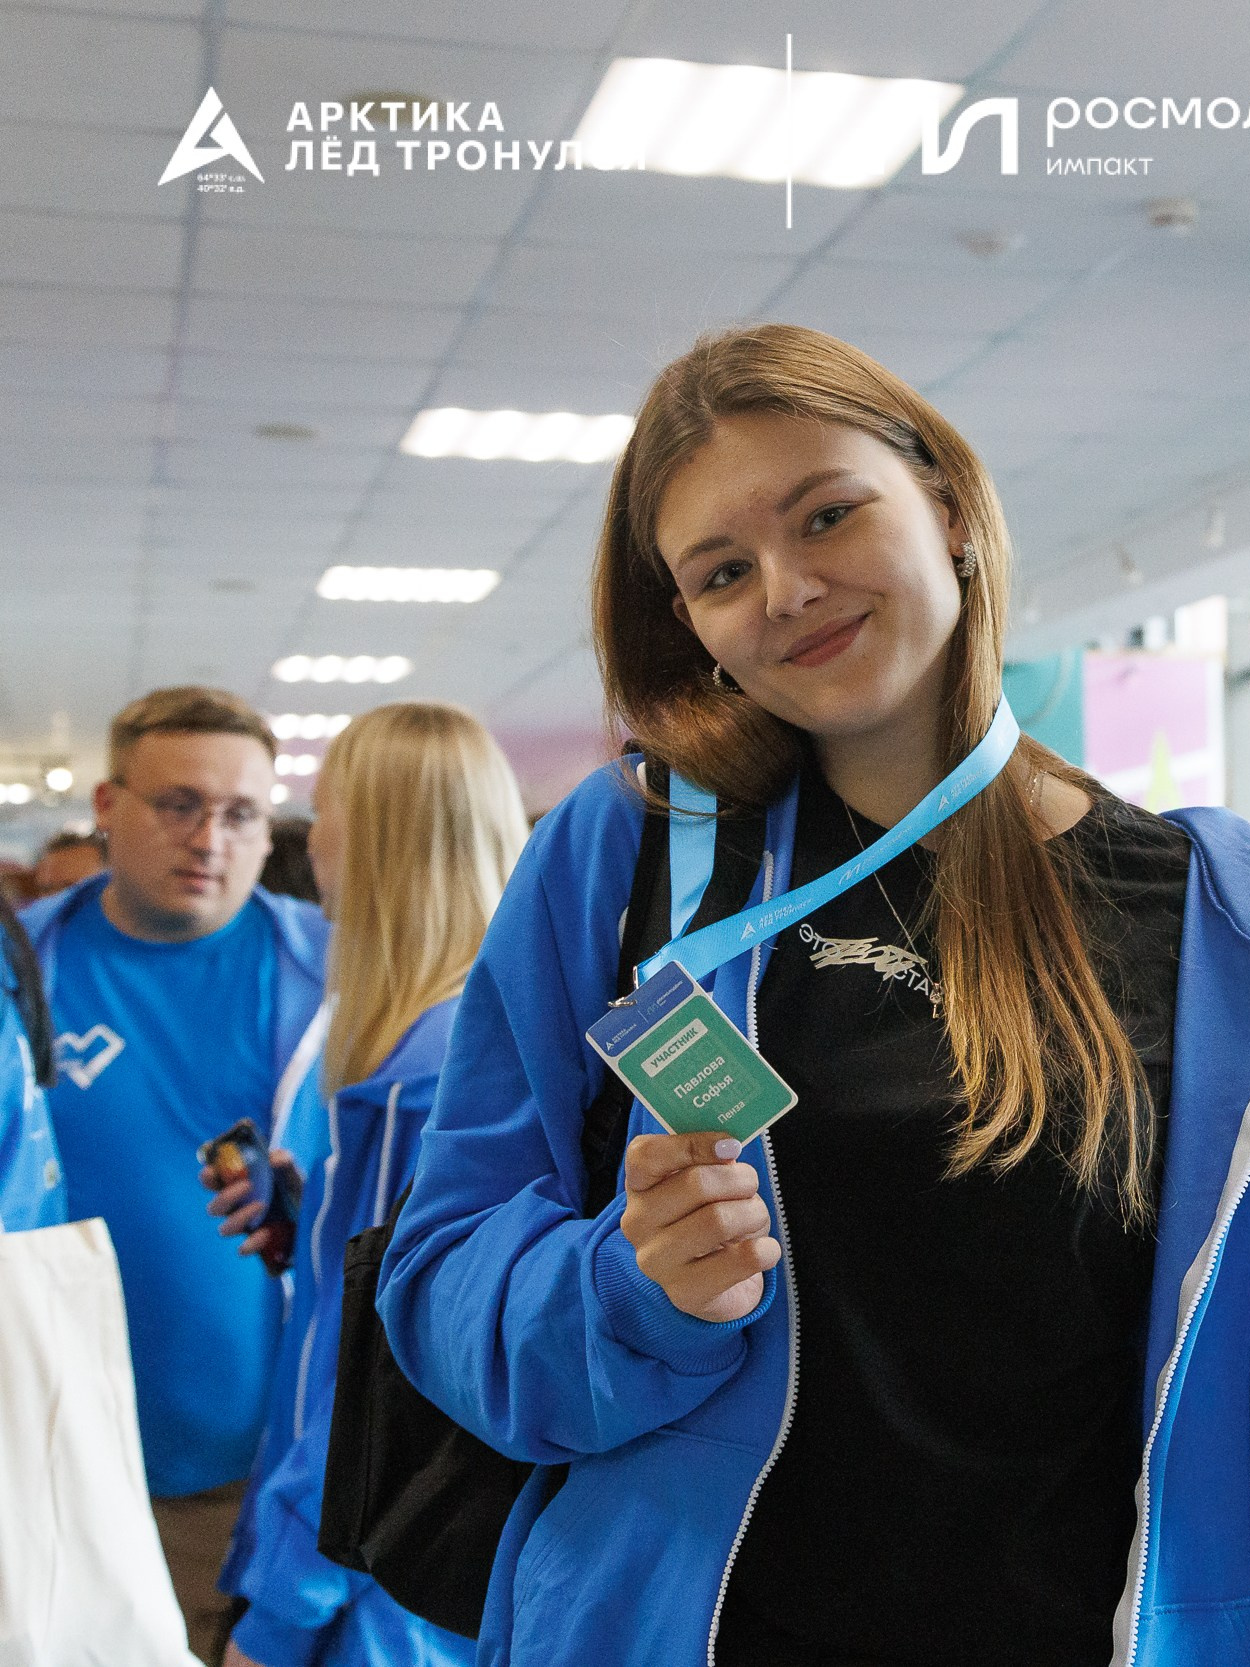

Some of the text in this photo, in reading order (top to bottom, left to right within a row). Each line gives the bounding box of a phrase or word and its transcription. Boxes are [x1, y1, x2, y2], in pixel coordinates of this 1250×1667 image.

[651, 1027, 699, 1068] УЧАСТНИК
[674, 1056, 726, 1099] Павлова
[693, 1075, 734, 1108] Софья
[717, 1100, 746, 1124] Пенза
